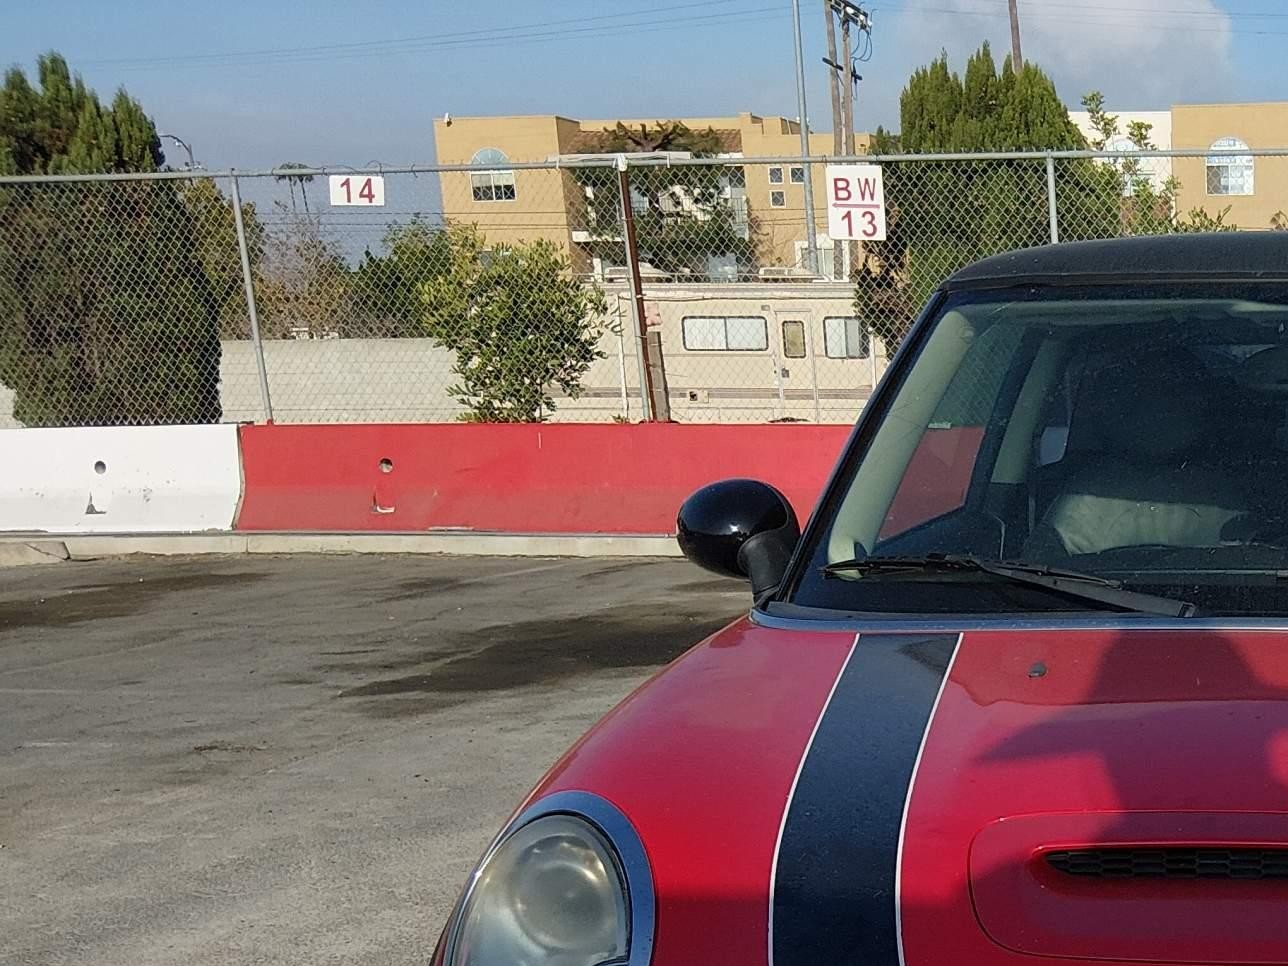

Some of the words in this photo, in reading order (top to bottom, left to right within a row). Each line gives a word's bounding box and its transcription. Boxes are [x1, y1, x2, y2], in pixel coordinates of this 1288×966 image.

[340, 177, 375, 204] 14
[833, 177, 876, 202] BW
[841, 210, 878, 238] 13
